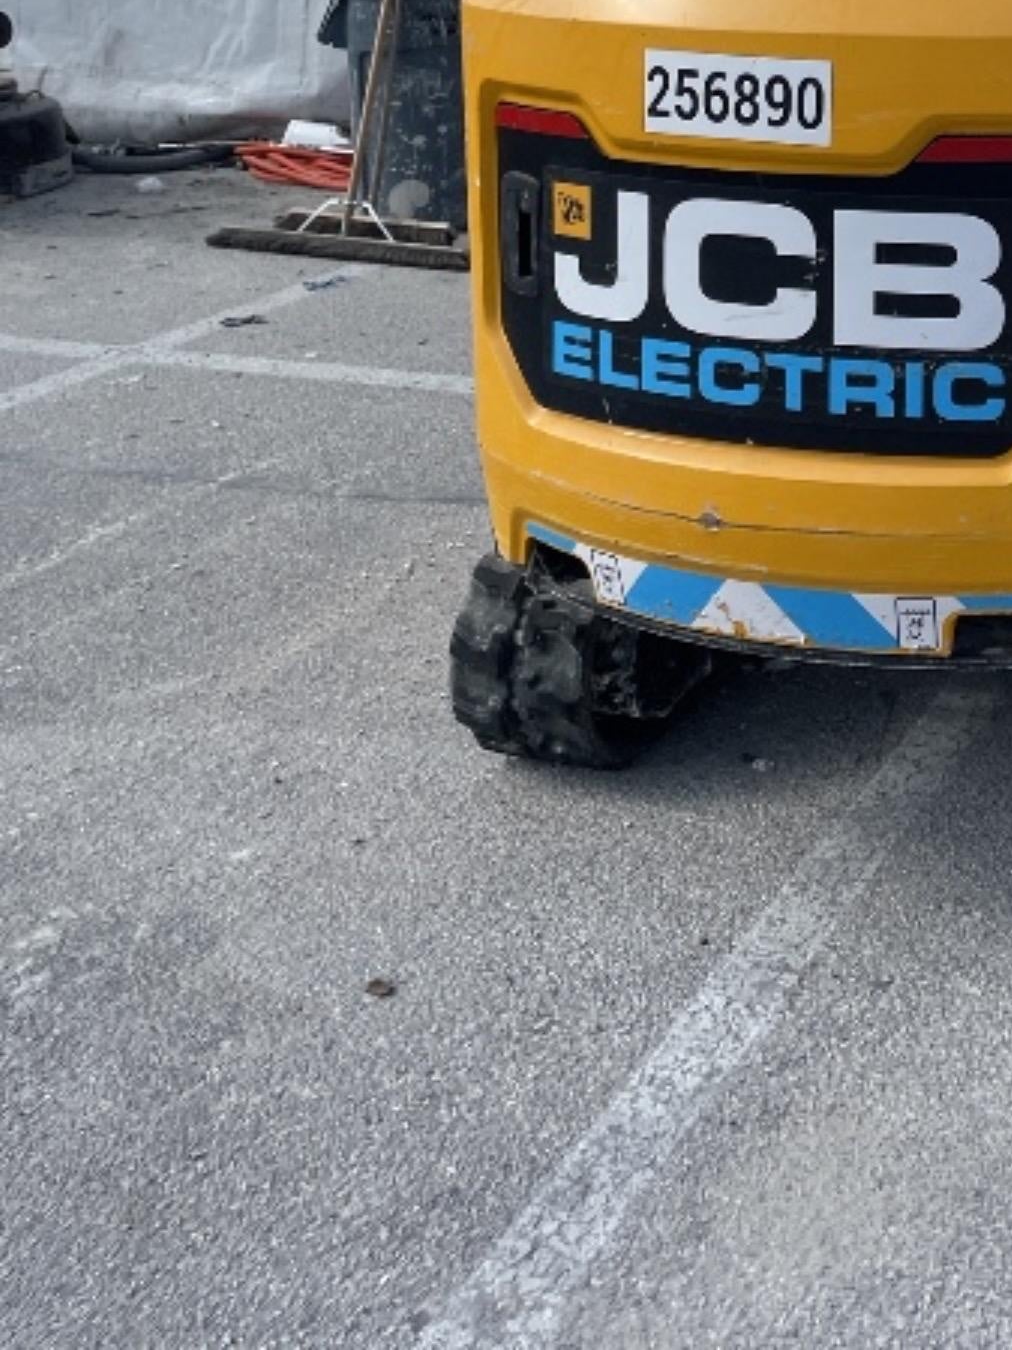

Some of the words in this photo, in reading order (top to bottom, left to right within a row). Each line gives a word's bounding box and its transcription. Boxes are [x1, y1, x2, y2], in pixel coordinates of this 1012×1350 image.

[646, 64, 826, 131] 256890
[553, 189, 1007, 351] JCB
[552, 320, 1007, 422] ELECTRIC
